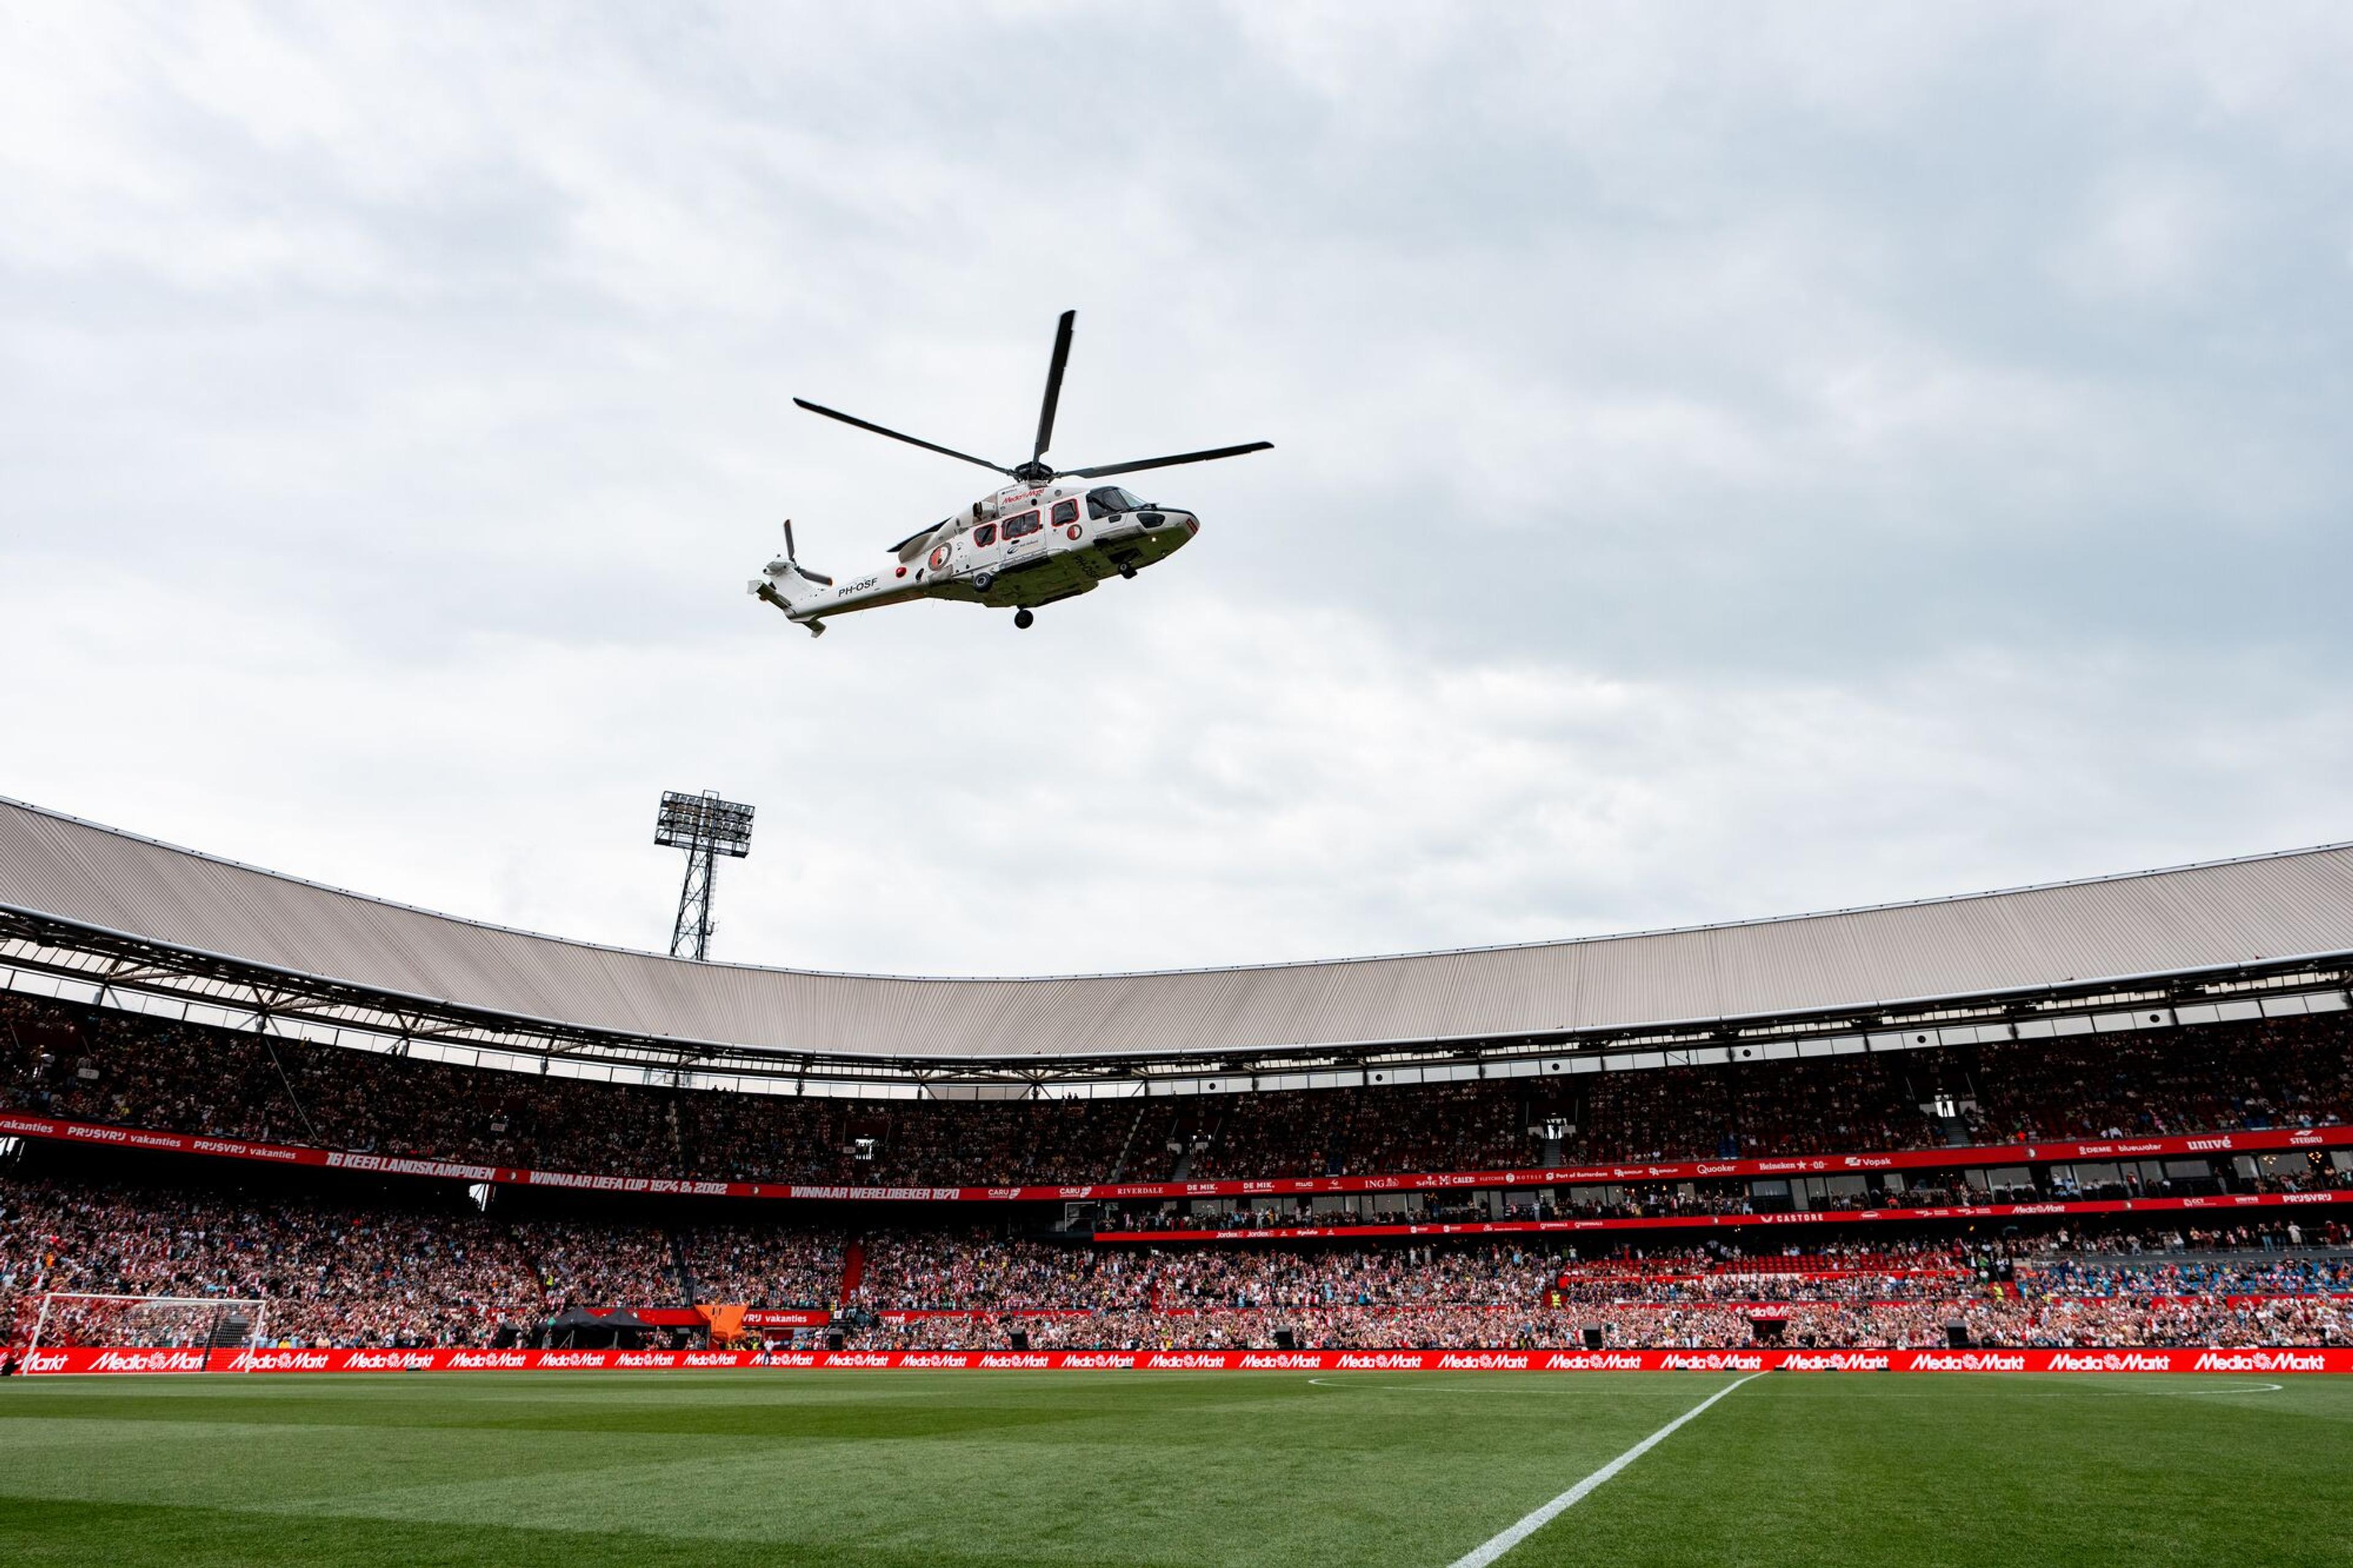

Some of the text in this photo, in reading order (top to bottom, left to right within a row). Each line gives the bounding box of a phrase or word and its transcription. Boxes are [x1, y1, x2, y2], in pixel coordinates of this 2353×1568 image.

[838, 577, 878, 597] PH-OSF
[130, 1134, 181, 1148] vakanties
[2186, 1135, 2232, 1150] univé
[249, 1148, 297, 1159] vakanties
[325, 1152, 496, 1180] 16 KEER LANDSKAMPIOEN
[1697, 1164, 1737, 1175] Quooker
[1759, 1162, 1796, 1171] Heineken
[1862, 1158, 1892, 1167] Vopak
[529, 1171, 728, 1195] WINNAAR UEFA CUP 1974 & 2002
[790, 1186, 960, 1200] WINNAAR WERELDBEKER 1970
[1776, 1214, 1824, 1222] CASTORE
[765, 1314, 808, 1322] vakanties
[88, 1352, 149, 1370] Media
[287, 1352, 328, 1369] Markt
[343, 1352, 434, 1368] Media Markt
[447, 1352, 526, 1366] Media Markt
[537, 1353, 605, 1366] Media Markt
[615, 1353, 675, 1365] Media Markt
[683, 1354, 737, 1365] Media Markt
[787, 1354, 814, 1365] Markt
[824, 1354, 889, 1366] Media Markt
[899, 1354, 968, 1366] Media Markt
[979, 1355, 1049, 1367] Media Markt
[1061, 1354, 1135, 1367] Media Markt
[1147, 1354, 1226, 1367] Media Markt
[1239, 1354, 1321, 1368] Media Markt
[1336, 1354, 1422, 1368] Media Markt
[1437, 1354, 1529, 1368] Media Markt
[1545, 1354, 1642, 1368] Media Markt
[1660, 1354, 1762, 1369] Media Markt
[1780, 1354, 1889, 1369] Media Markt
[1909, 1354, 2025, 1369] Media Markt
[2047, 1354, 2171, 1370] Media Markt
[2194, 1352, 2325, 1369] Media Markt
